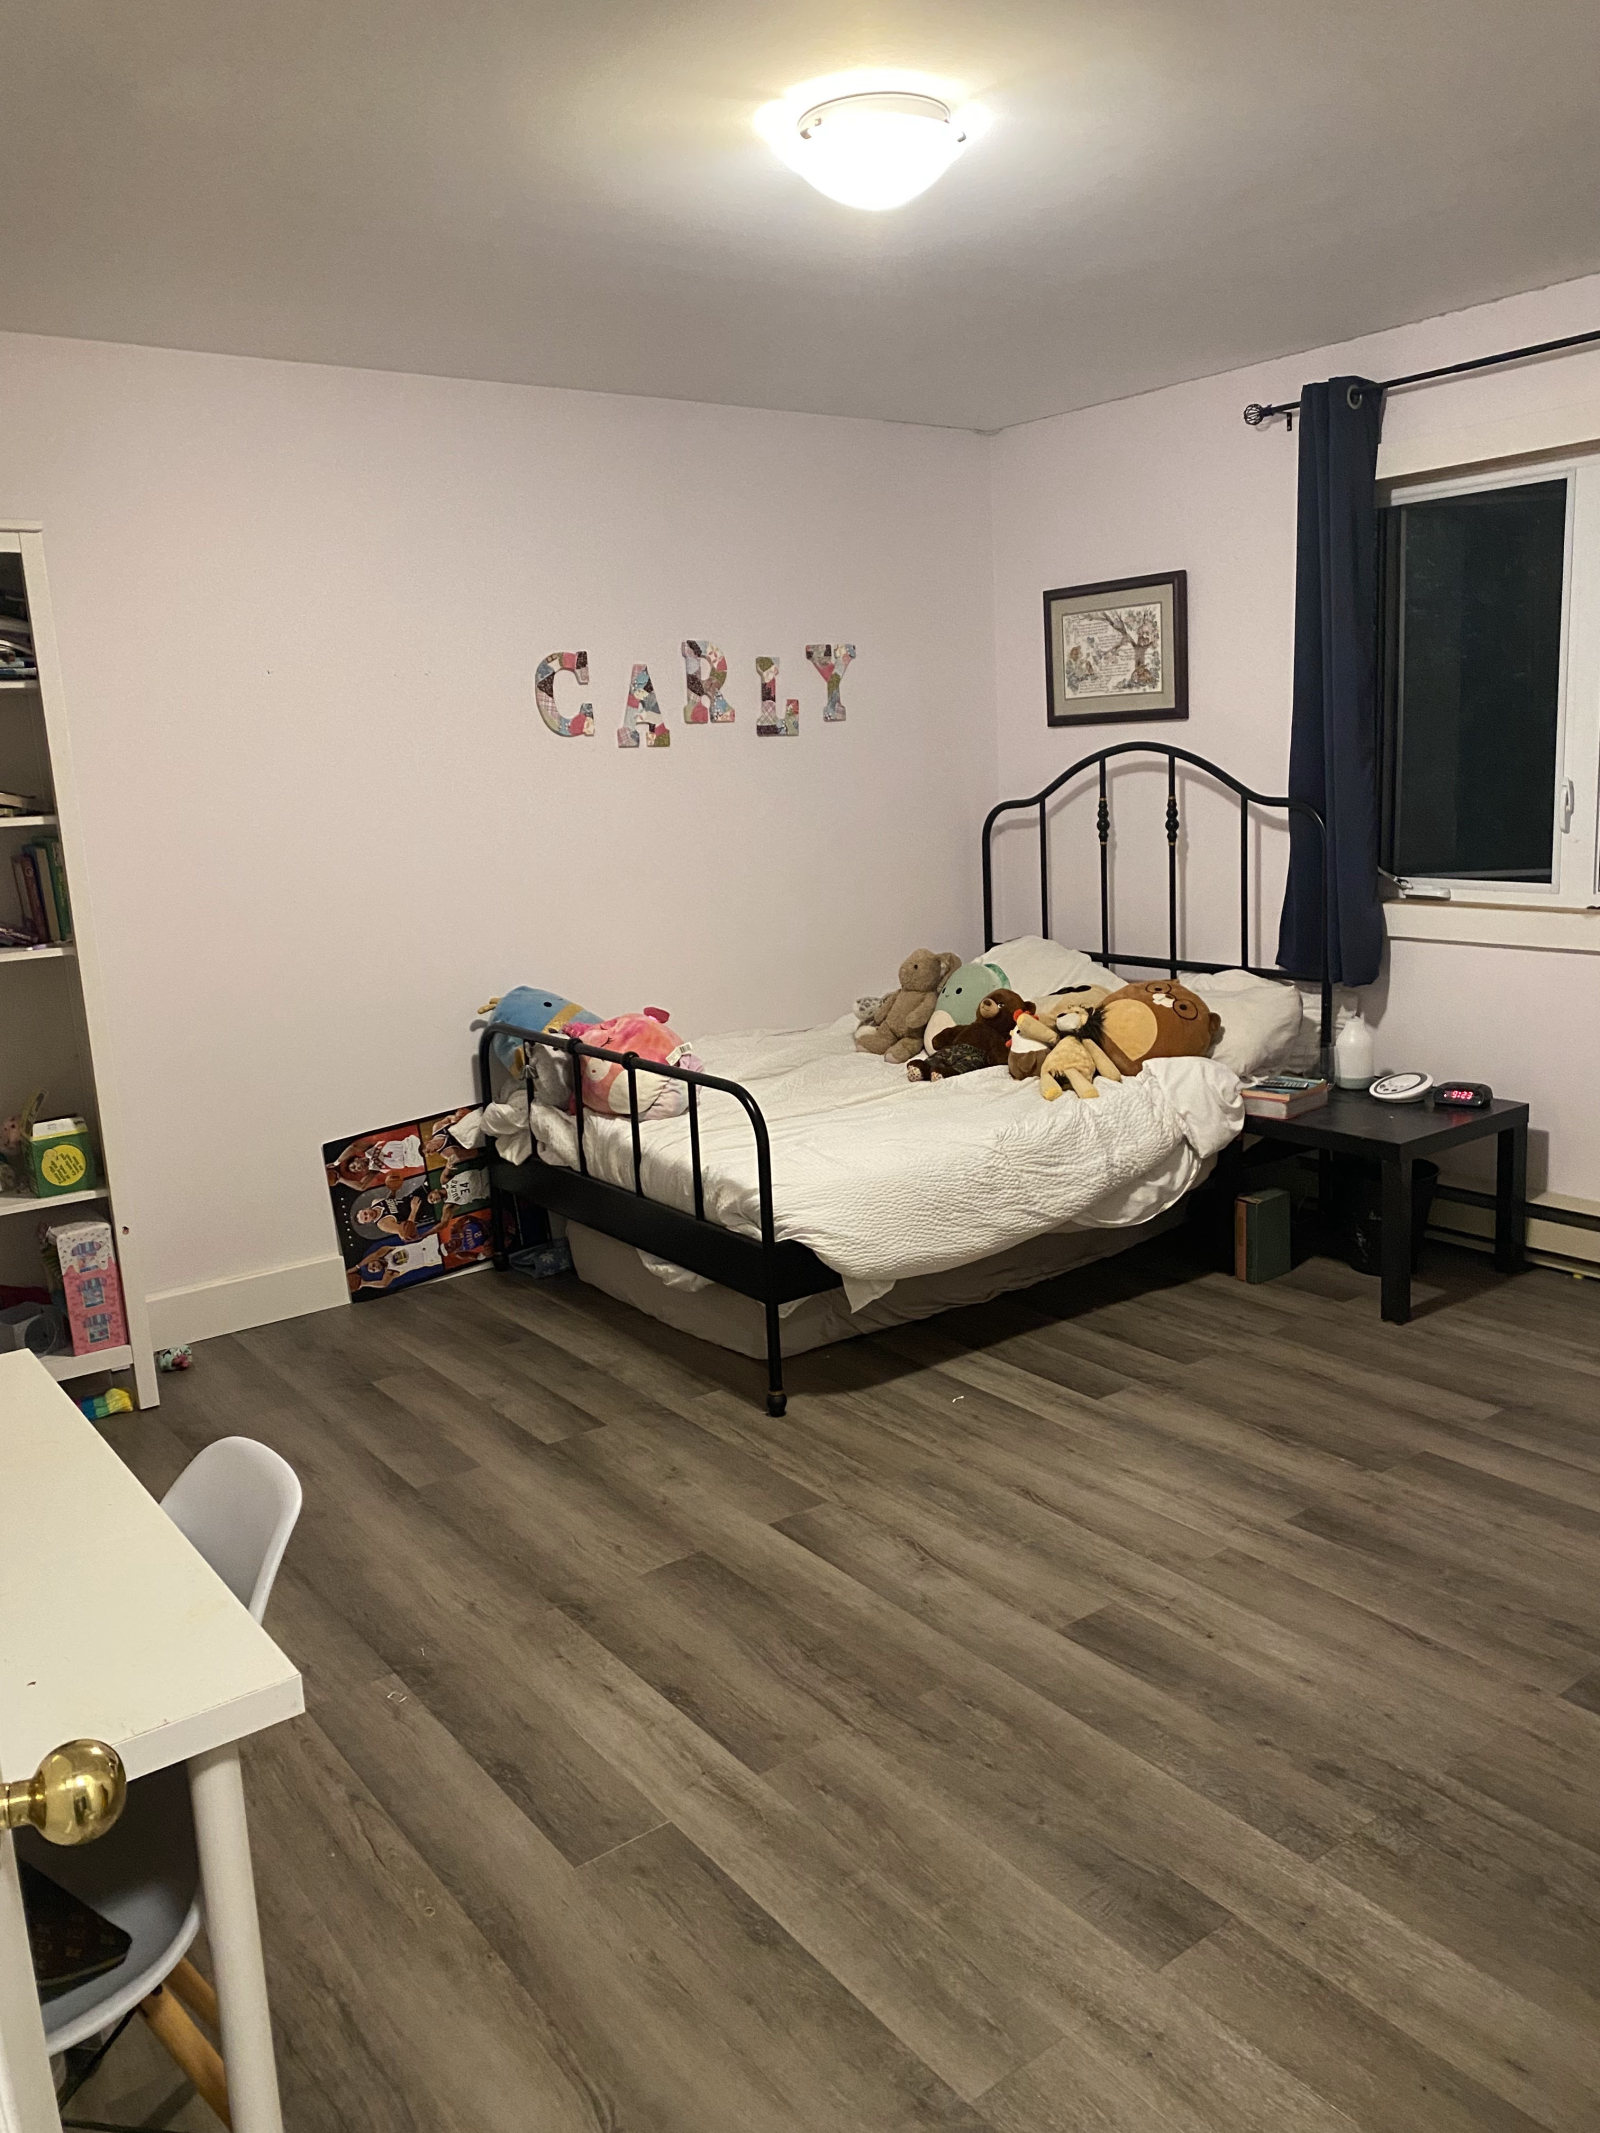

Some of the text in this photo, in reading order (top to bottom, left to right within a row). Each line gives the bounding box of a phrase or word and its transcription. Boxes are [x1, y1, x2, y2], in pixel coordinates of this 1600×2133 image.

[535, 640, 857, 748] CARLY
[1451, 1090, 1474, 1100] 9:23
[450, 1179, 461, 1202] BUCKS
[459, 1182, 470, 1195] 34
